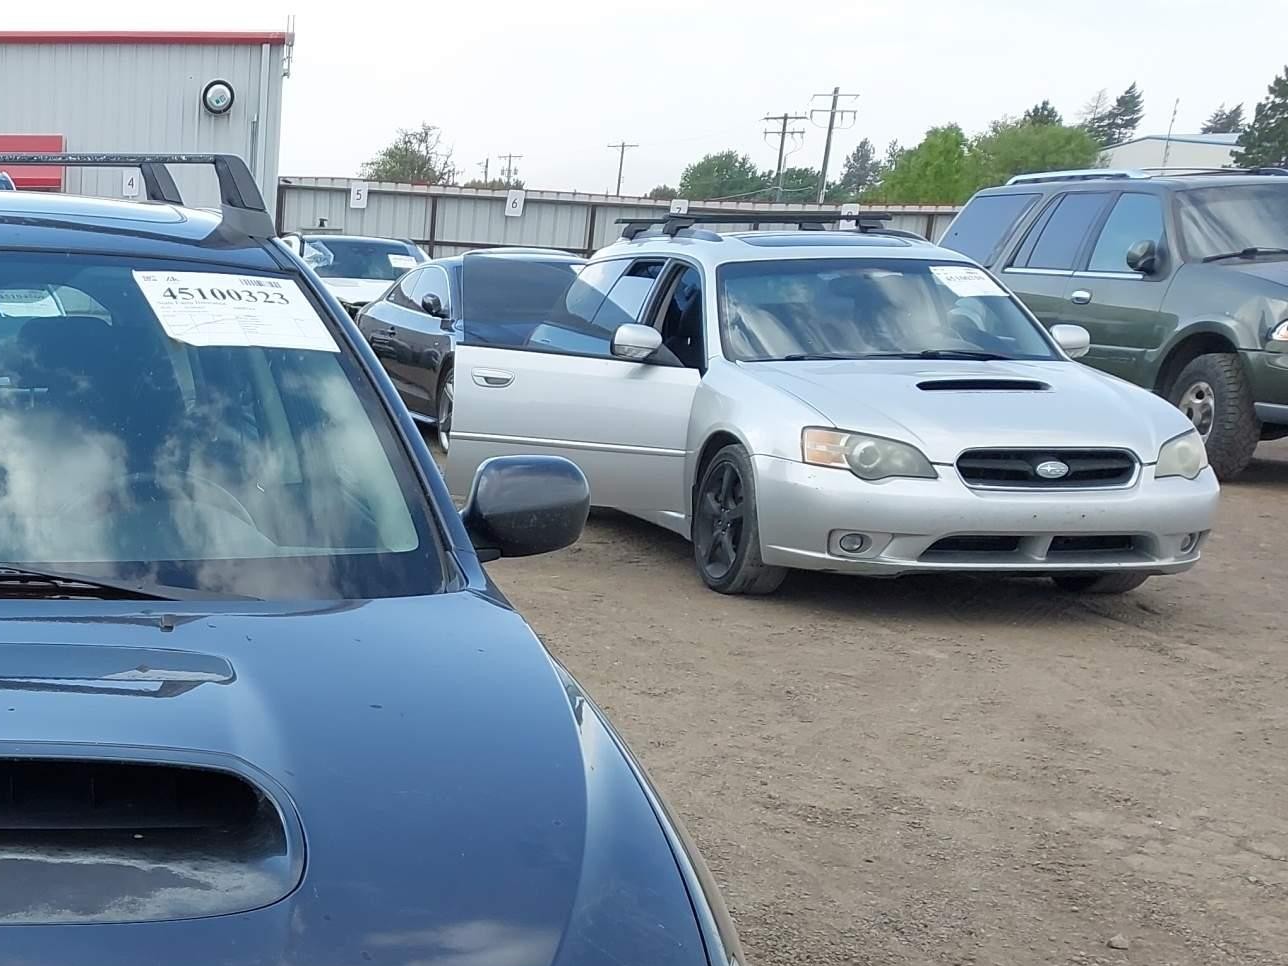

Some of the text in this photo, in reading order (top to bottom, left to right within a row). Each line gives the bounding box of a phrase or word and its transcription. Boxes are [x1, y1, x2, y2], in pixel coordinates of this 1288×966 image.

[127, 176, 135, 189] 4
[356, 189, 362, 201] 5
[511, 198, 518, 209] 6
[162, 287, 290, 305] 45100323
